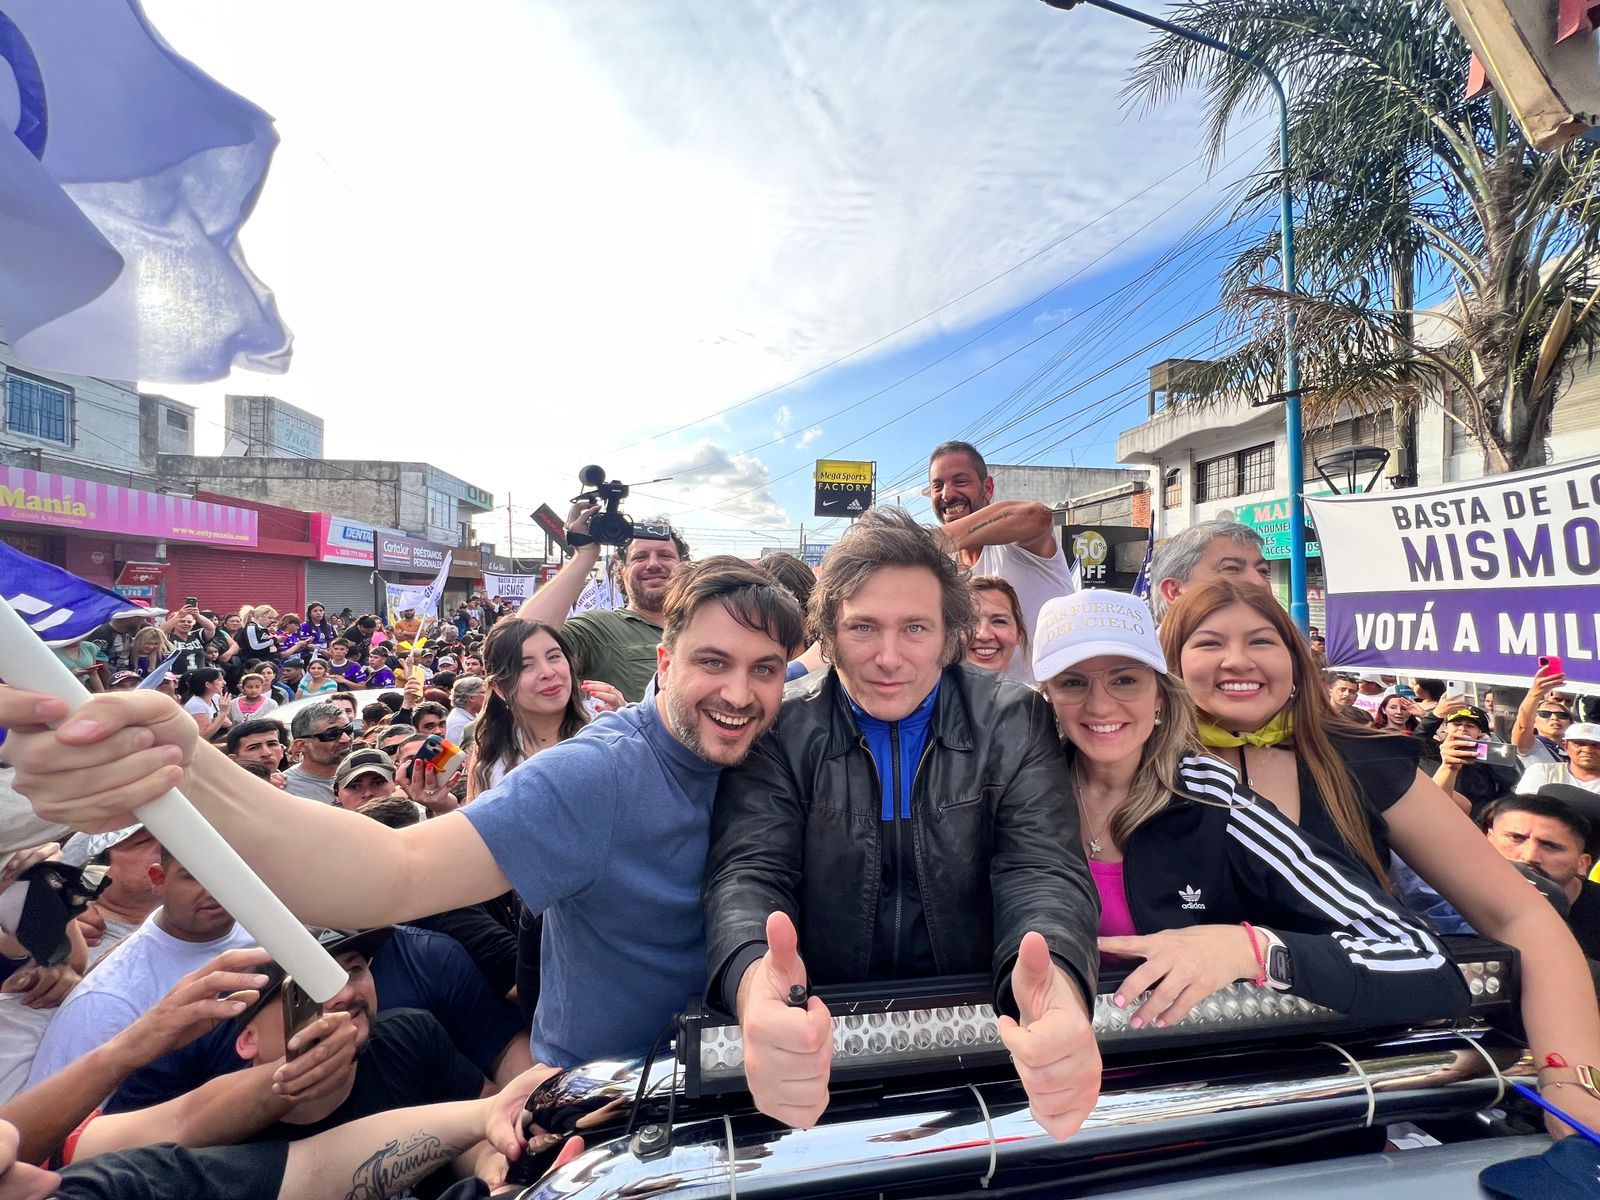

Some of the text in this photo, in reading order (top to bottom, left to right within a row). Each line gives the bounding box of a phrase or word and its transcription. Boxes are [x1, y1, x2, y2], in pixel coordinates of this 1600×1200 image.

[818, 483, 869, 492] FACTORY
[821, 472, 867, 481] Mega Sports
[1392, 496, 1491, 530] BASTA
[1502, 485, 1551, 520] DE
[1076, 538, 1107, 560] 50%
[1401, 517, 1600, 583] MISMO
[498, 584, 524, 596] MISMOS
[1044, 601, 1143, 629] LAS FUERZAS
[1354, 601, 1439, 652] VOTÁ
[1452, 612, 1481, 653] A
[1046, 616, 1145, 643] DEL CIELO
[1181, 902, 1206, 910] adidas
